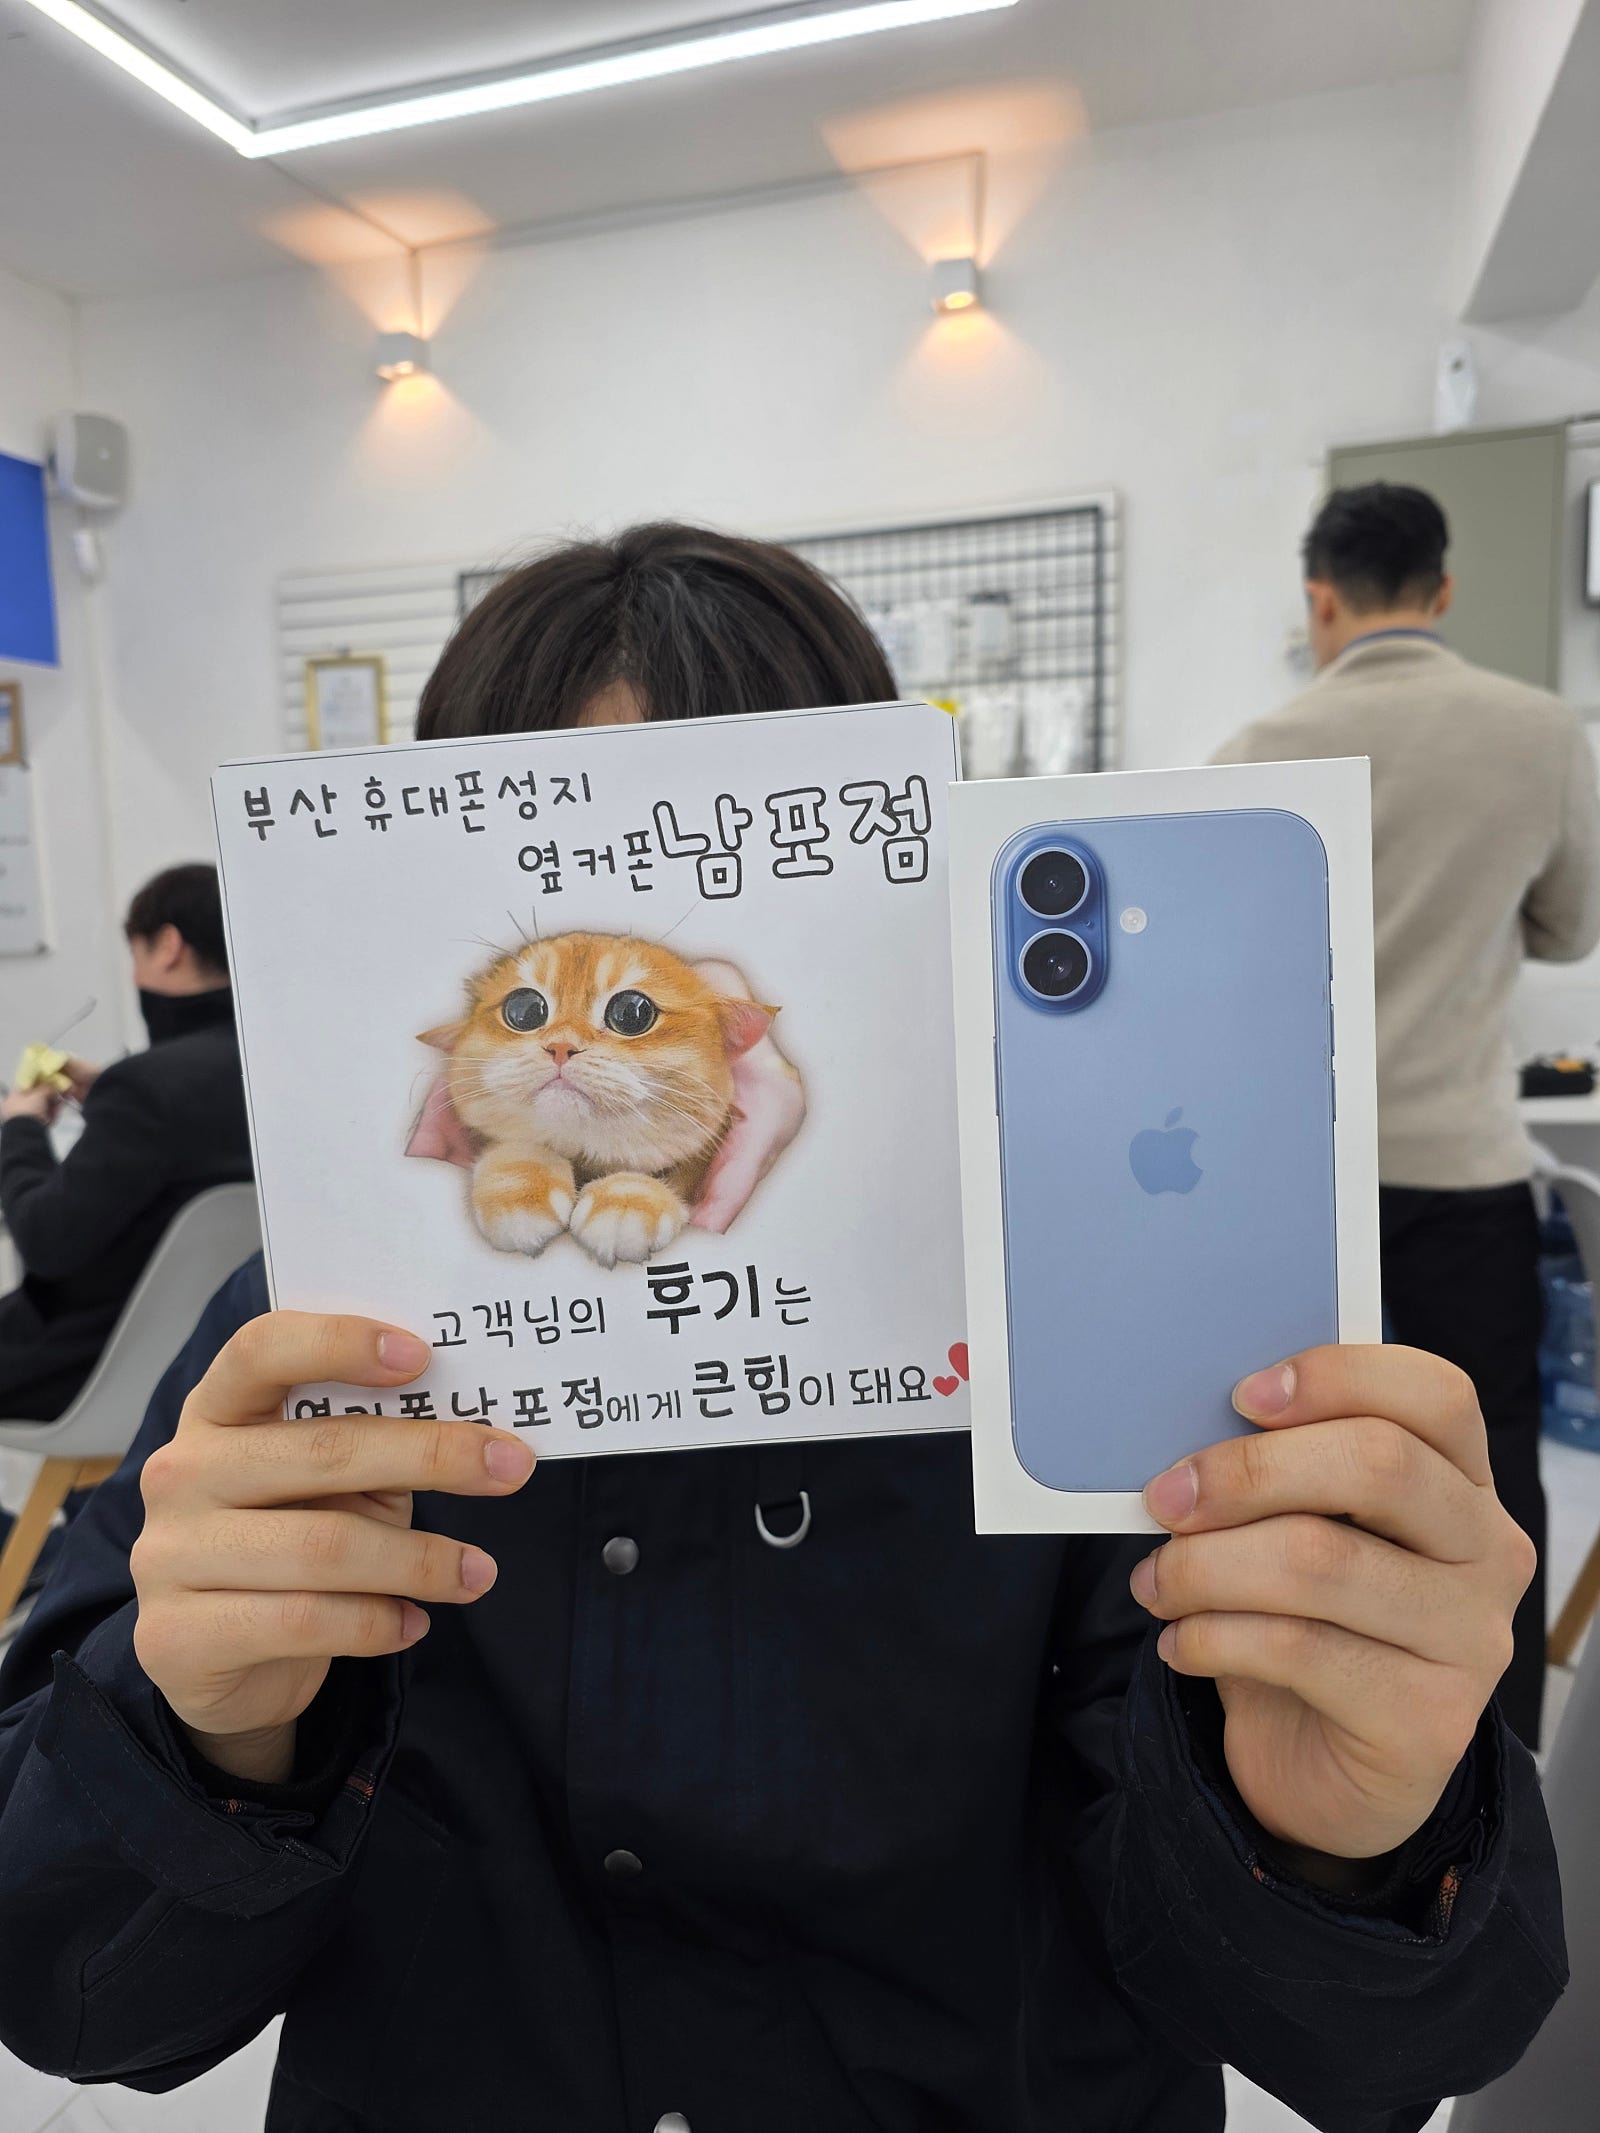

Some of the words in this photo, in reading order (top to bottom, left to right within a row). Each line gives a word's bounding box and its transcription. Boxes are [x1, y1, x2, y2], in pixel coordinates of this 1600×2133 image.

[244, 783, 338, 841] 부산
[432, 1296, 606, 1348] 고객님의
[646, 1261, 812, 1335] 후기는
[848, 1365, 932, 1406] 돼요
